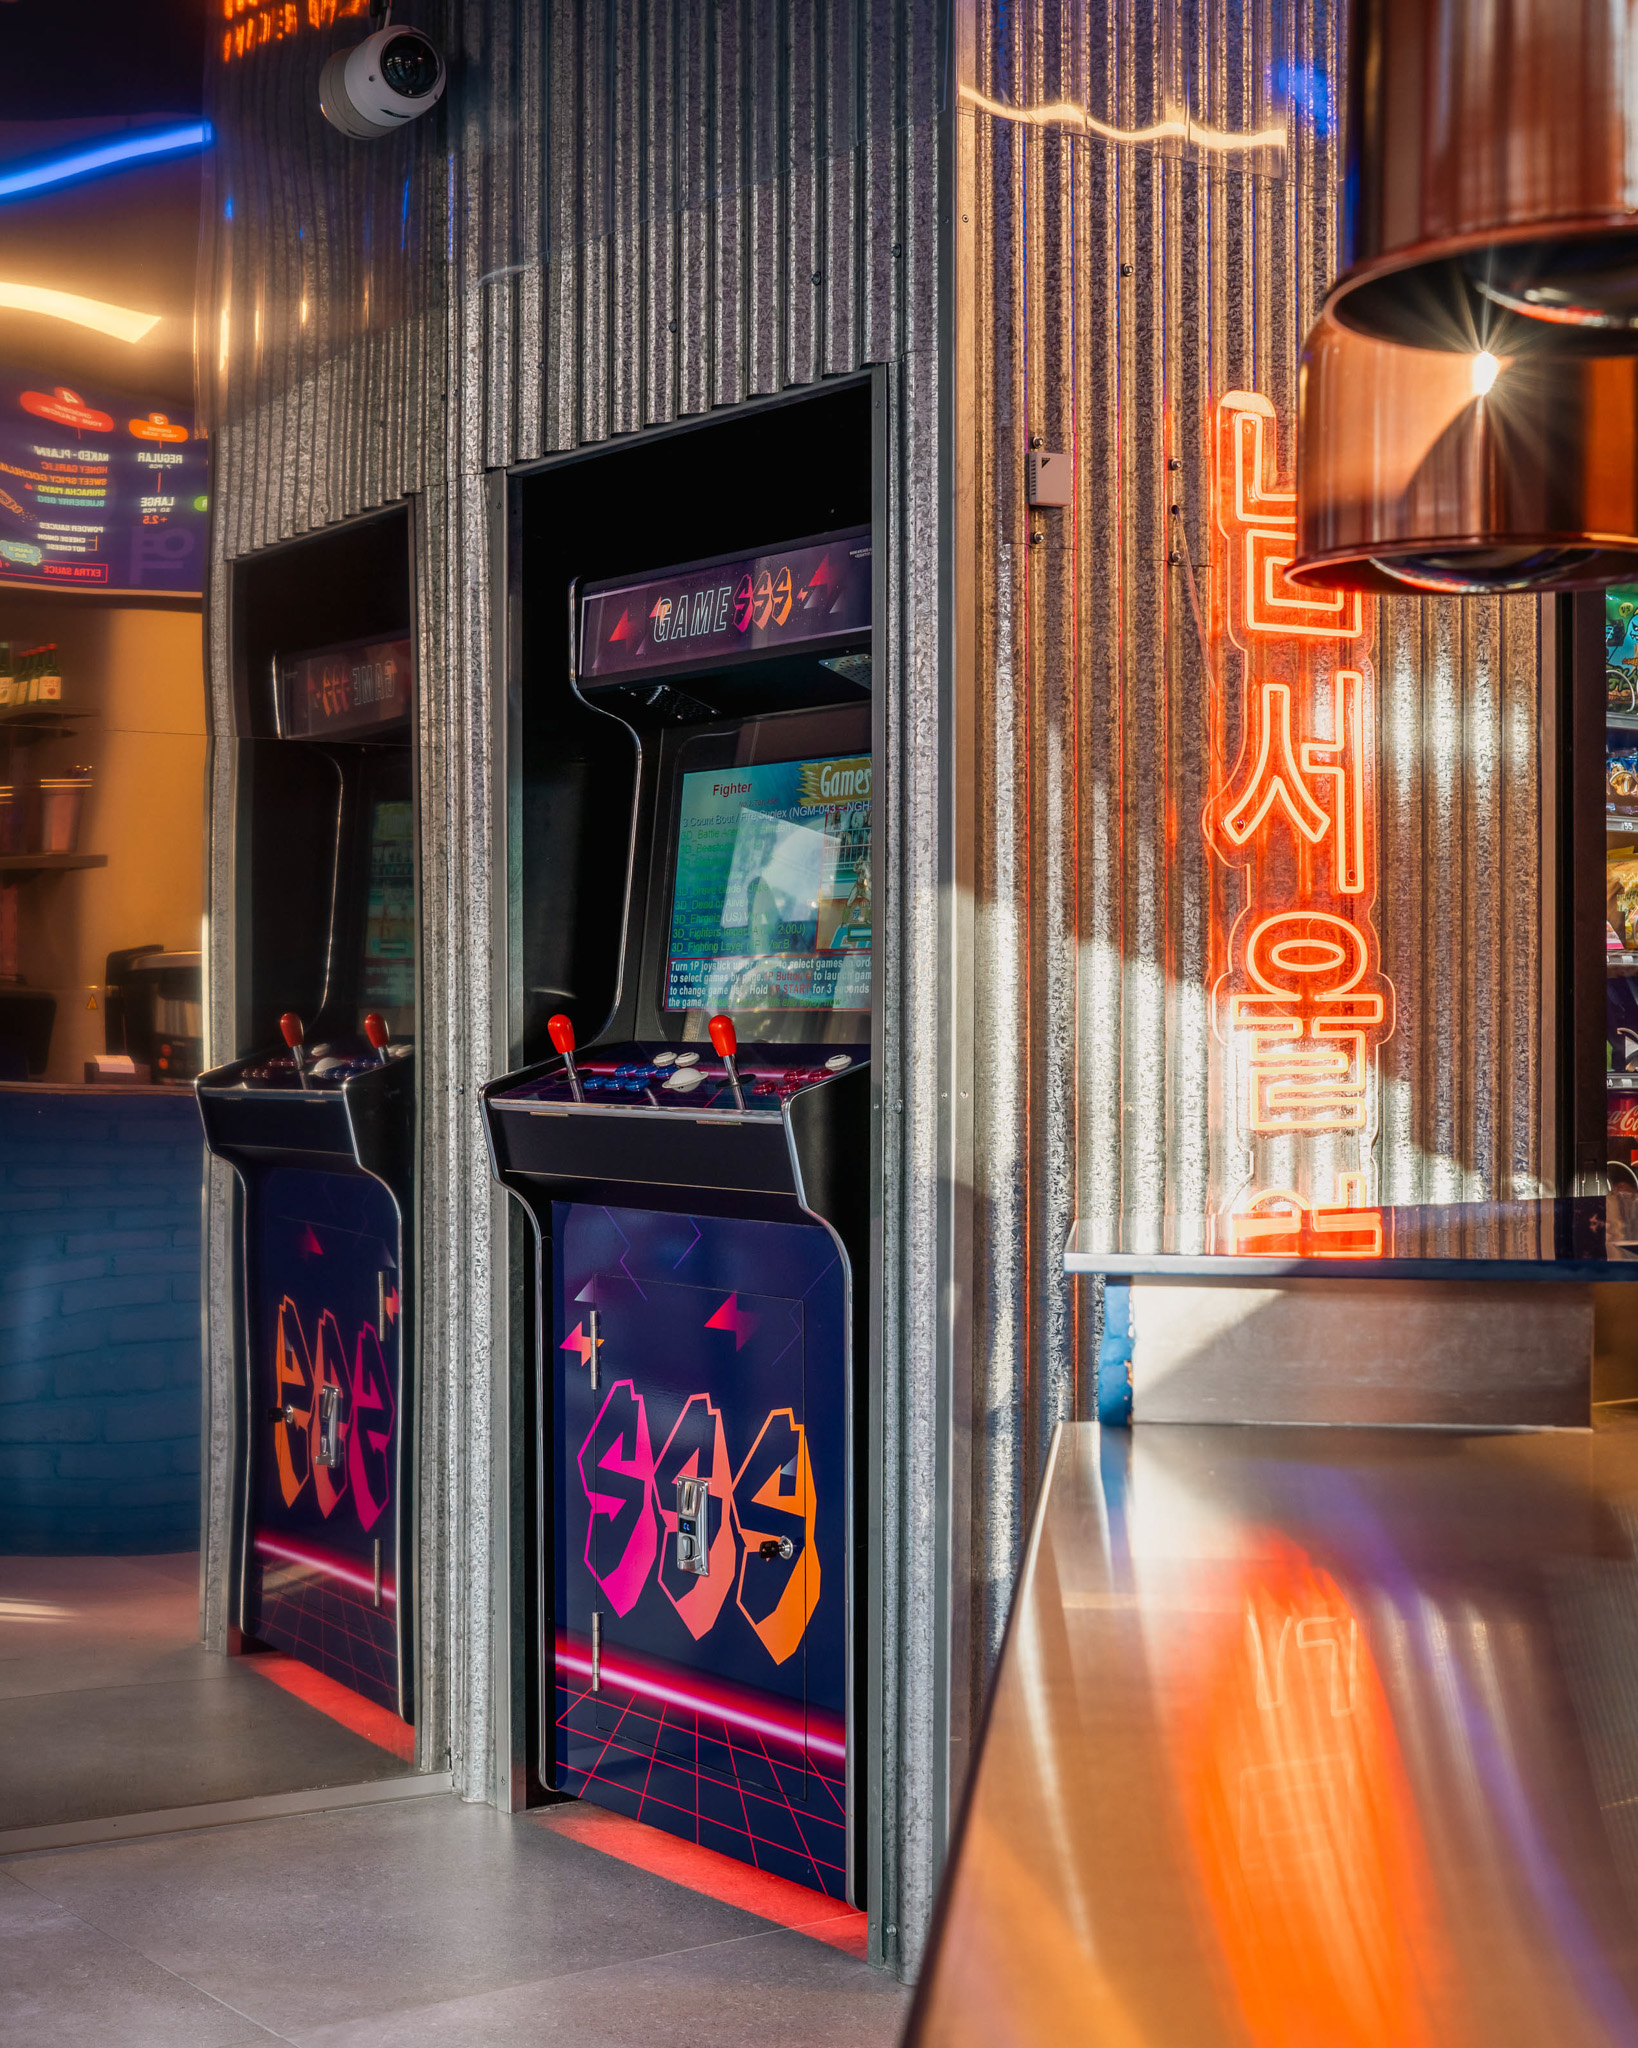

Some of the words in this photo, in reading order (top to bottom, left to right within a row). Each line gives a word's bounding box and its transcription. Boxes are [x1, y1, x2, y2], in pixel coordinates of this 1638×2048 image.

[653, 586, 732, 643] GAME
[712, 782, 753, 798] Fighter
[682, 818, 688, 827] 3
[690, 816, 714, 827] Count
[716, 815, 733, 826] Bout
[788, 804, 836, 820] (NGM-043
[671, 941, 719, 955] 3D_Fighting
[671, 961, 688, 972] Turn
[689, 960, 700, 970] 1P
[701, 959, 731, 973] joystick
[789, 957, 814, 968] select
[815, 958, 843, 971] games
[670, 974, 678, 983] to
[680, 972, 702, 984] select
[704, 973, 730, 986] games
[731, 971, 740, 985] by
[743, 972, 764, 985] pge.
[776, 970, 803, 982] Button
[813, 971, 823, 981] to
[669, 986, 678, 996] to
[679, 984, 706, 998] change
[707, 986, 729, 998] game
[750, 984, 768, 995] Hold
[783, 984, 811, 995] START
[812, 983, 826, 994] for
[668, 998, 681, 1007] the
[682, 997, 704, 1009] game.
